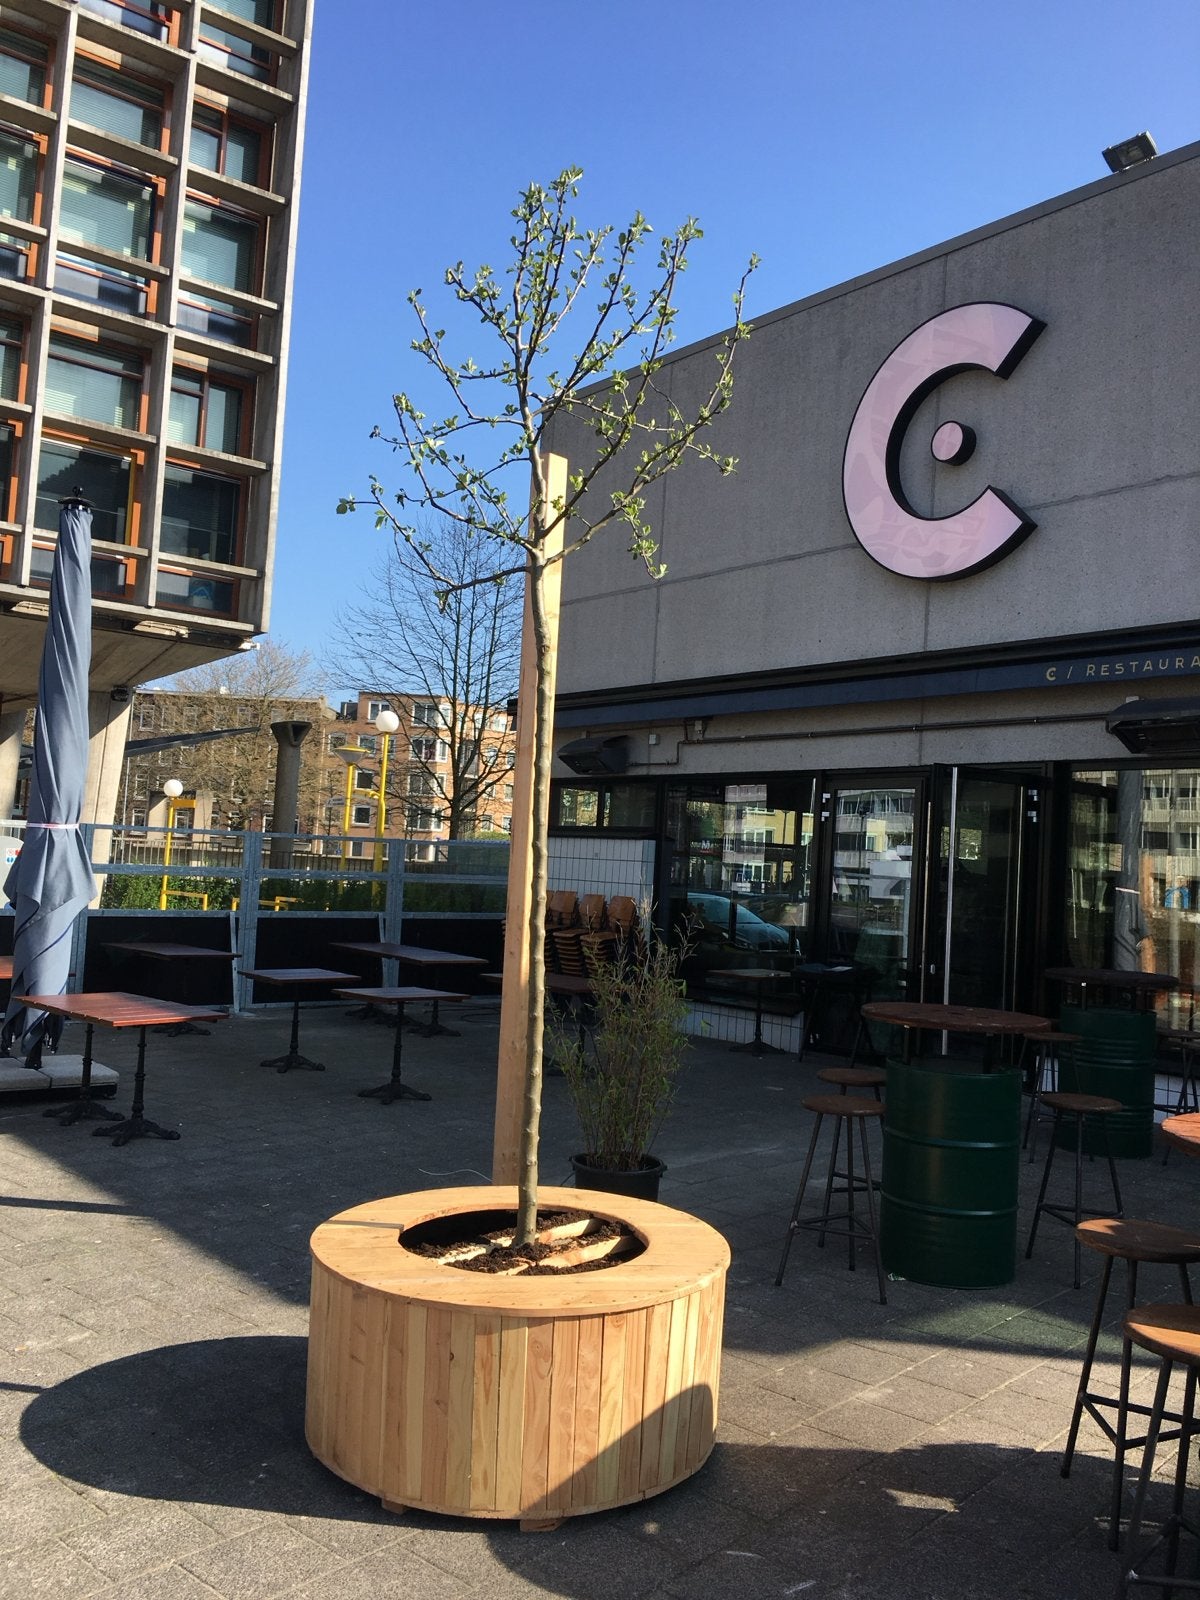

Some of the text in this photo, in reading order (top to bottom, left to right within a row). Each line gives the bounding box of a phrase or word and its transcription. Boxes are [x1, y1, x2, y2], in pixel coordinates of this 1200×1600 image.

[842, 301, 1047, 582] C
[1045, 667, 1057, 681] C
[1086, 655, 1200, 677] RESTAURA
